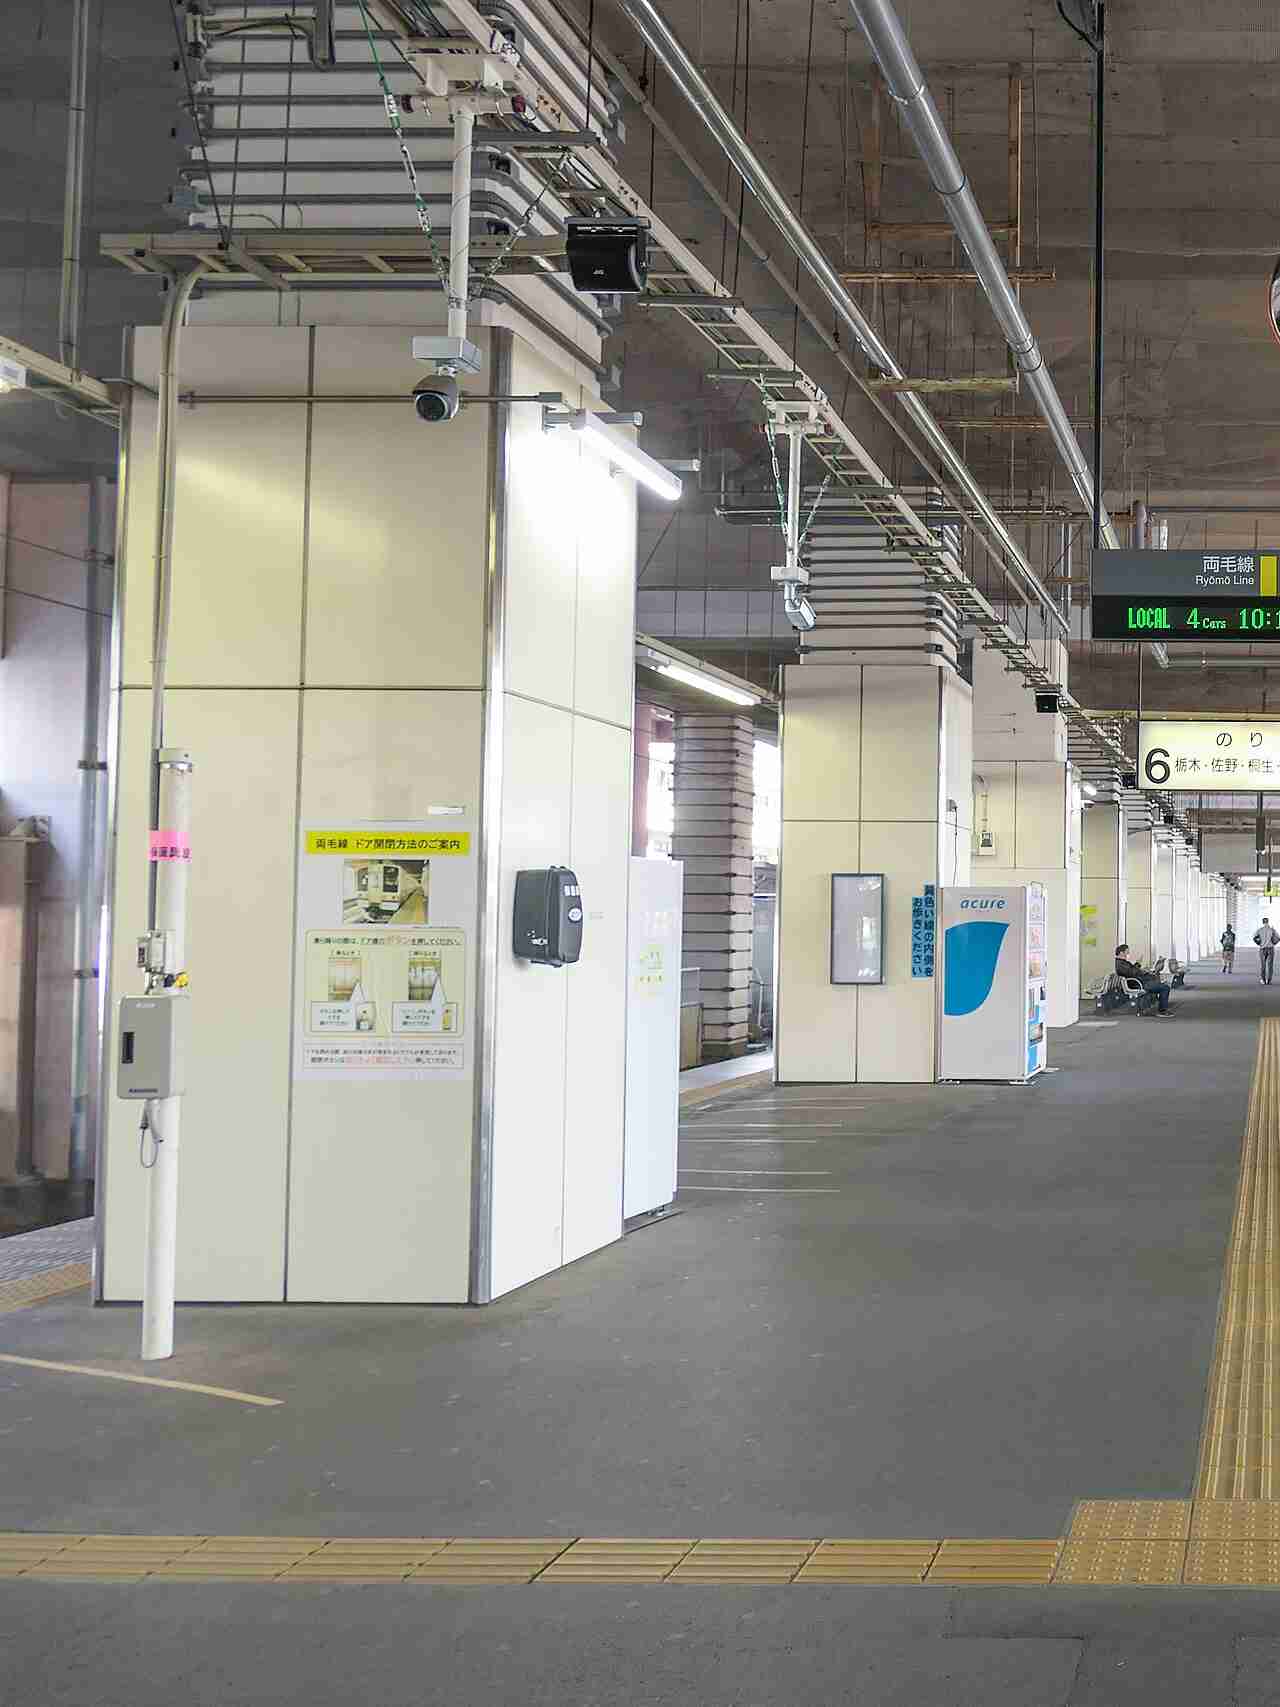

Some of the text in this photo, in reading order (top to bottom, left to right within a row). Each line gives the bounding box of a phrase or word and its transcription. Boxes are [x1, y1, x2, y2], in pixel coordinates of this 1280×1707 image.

[1203, 556, 1254, 573] 両毛線
[1234, 575, 1254, 585] Line
[1128, 607, 1170, 629] LOCAL
[1186, 607, 1200, 628] 4
[1203, 618, 1226, 629] Cars
[1145, 748, 1170, 784] 6
[315, 838, 460, 850] 両毛線 ドア開閉方法のご案内
[960, 899, 1005, 909] acure
